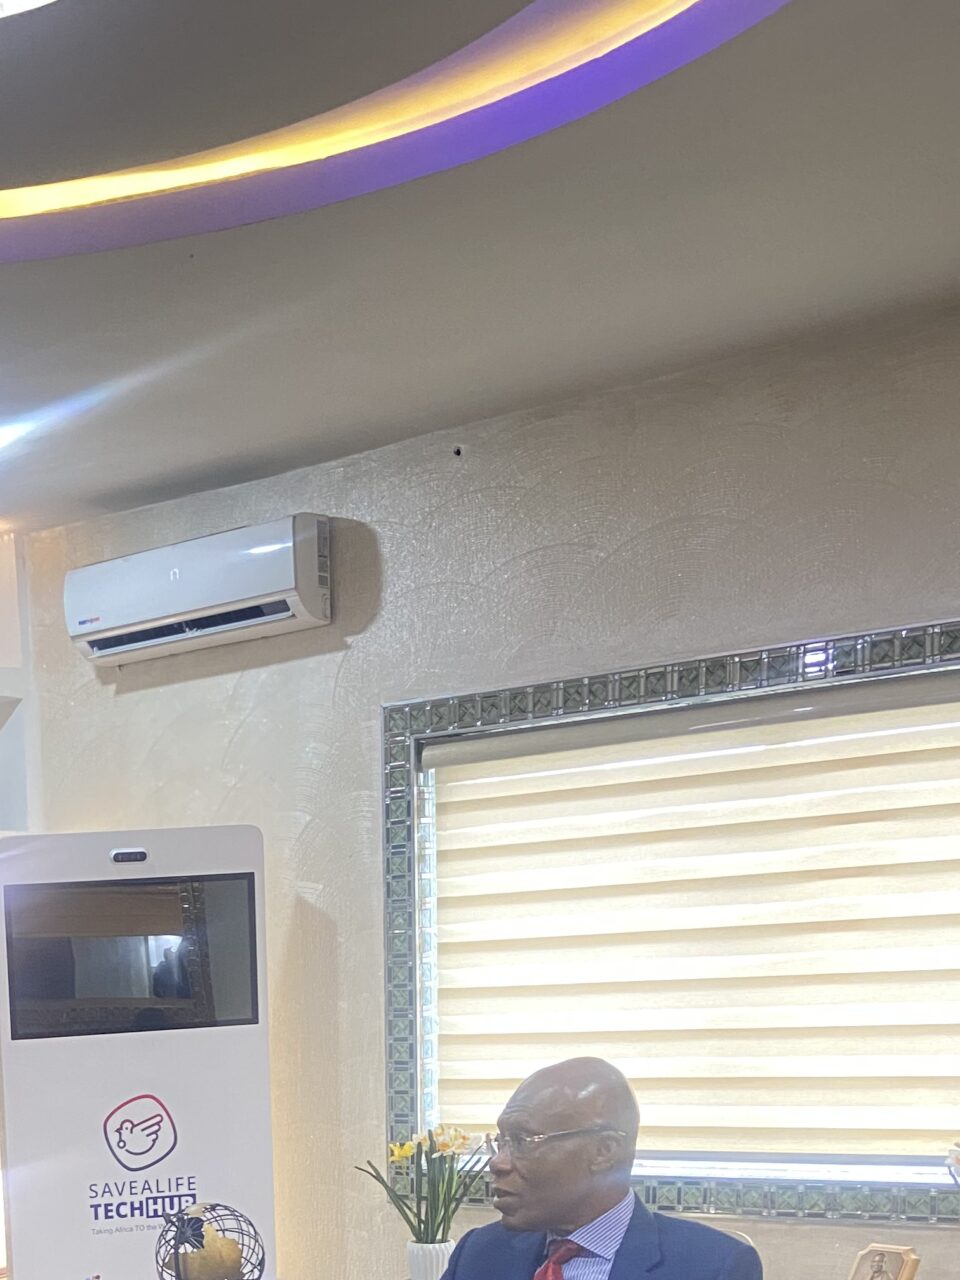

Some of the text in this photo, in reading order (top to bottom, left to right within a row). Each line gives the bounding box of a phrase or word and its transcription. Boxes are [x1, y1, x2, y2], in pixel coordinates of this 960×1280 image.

[89, 1176, 197, 1198] SAVEALIFE
[91, 1228, 114, 1236] Taking
[114, 1225, 134, 1234] Africa
[135, 1224, 146, 1232] TO
